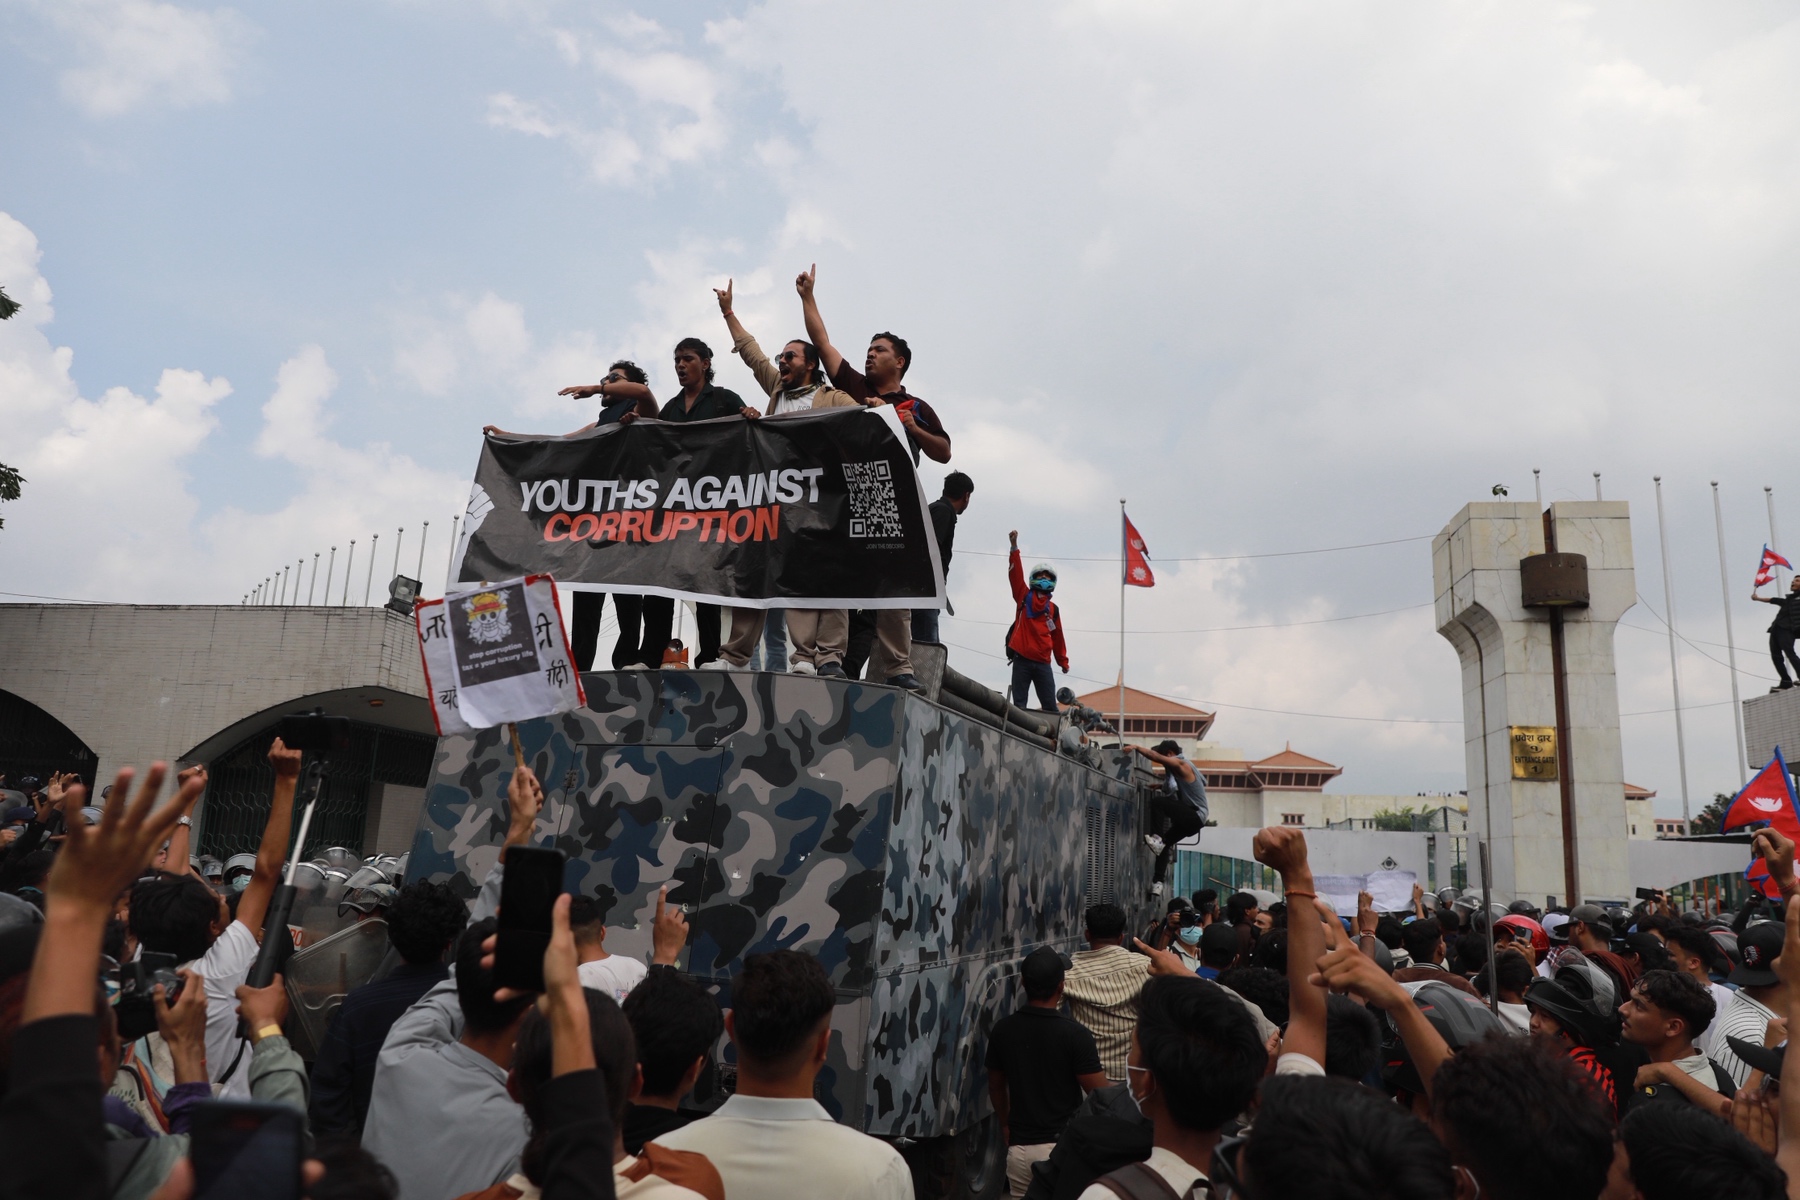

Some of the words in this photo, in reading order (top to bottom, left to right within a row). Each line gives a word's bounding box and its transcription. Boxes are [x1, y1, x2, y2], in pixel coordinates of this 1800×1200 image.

[519, 478, 661, 513] YOUTHS
[664, 467, 824, 509] AGAINST
[543, 504, 780, 544] CORRUPTION
[461, 663, 473, 672] tax
[481, 657, 496, 669] your
[497, 653, 521, 664] luxury
[521, 650, 534, 658] life
[468, 651, 484, 660] stop
[485, 643, 523, 657] corruption
[1515, 732, 1534, 742] प्रवेश
